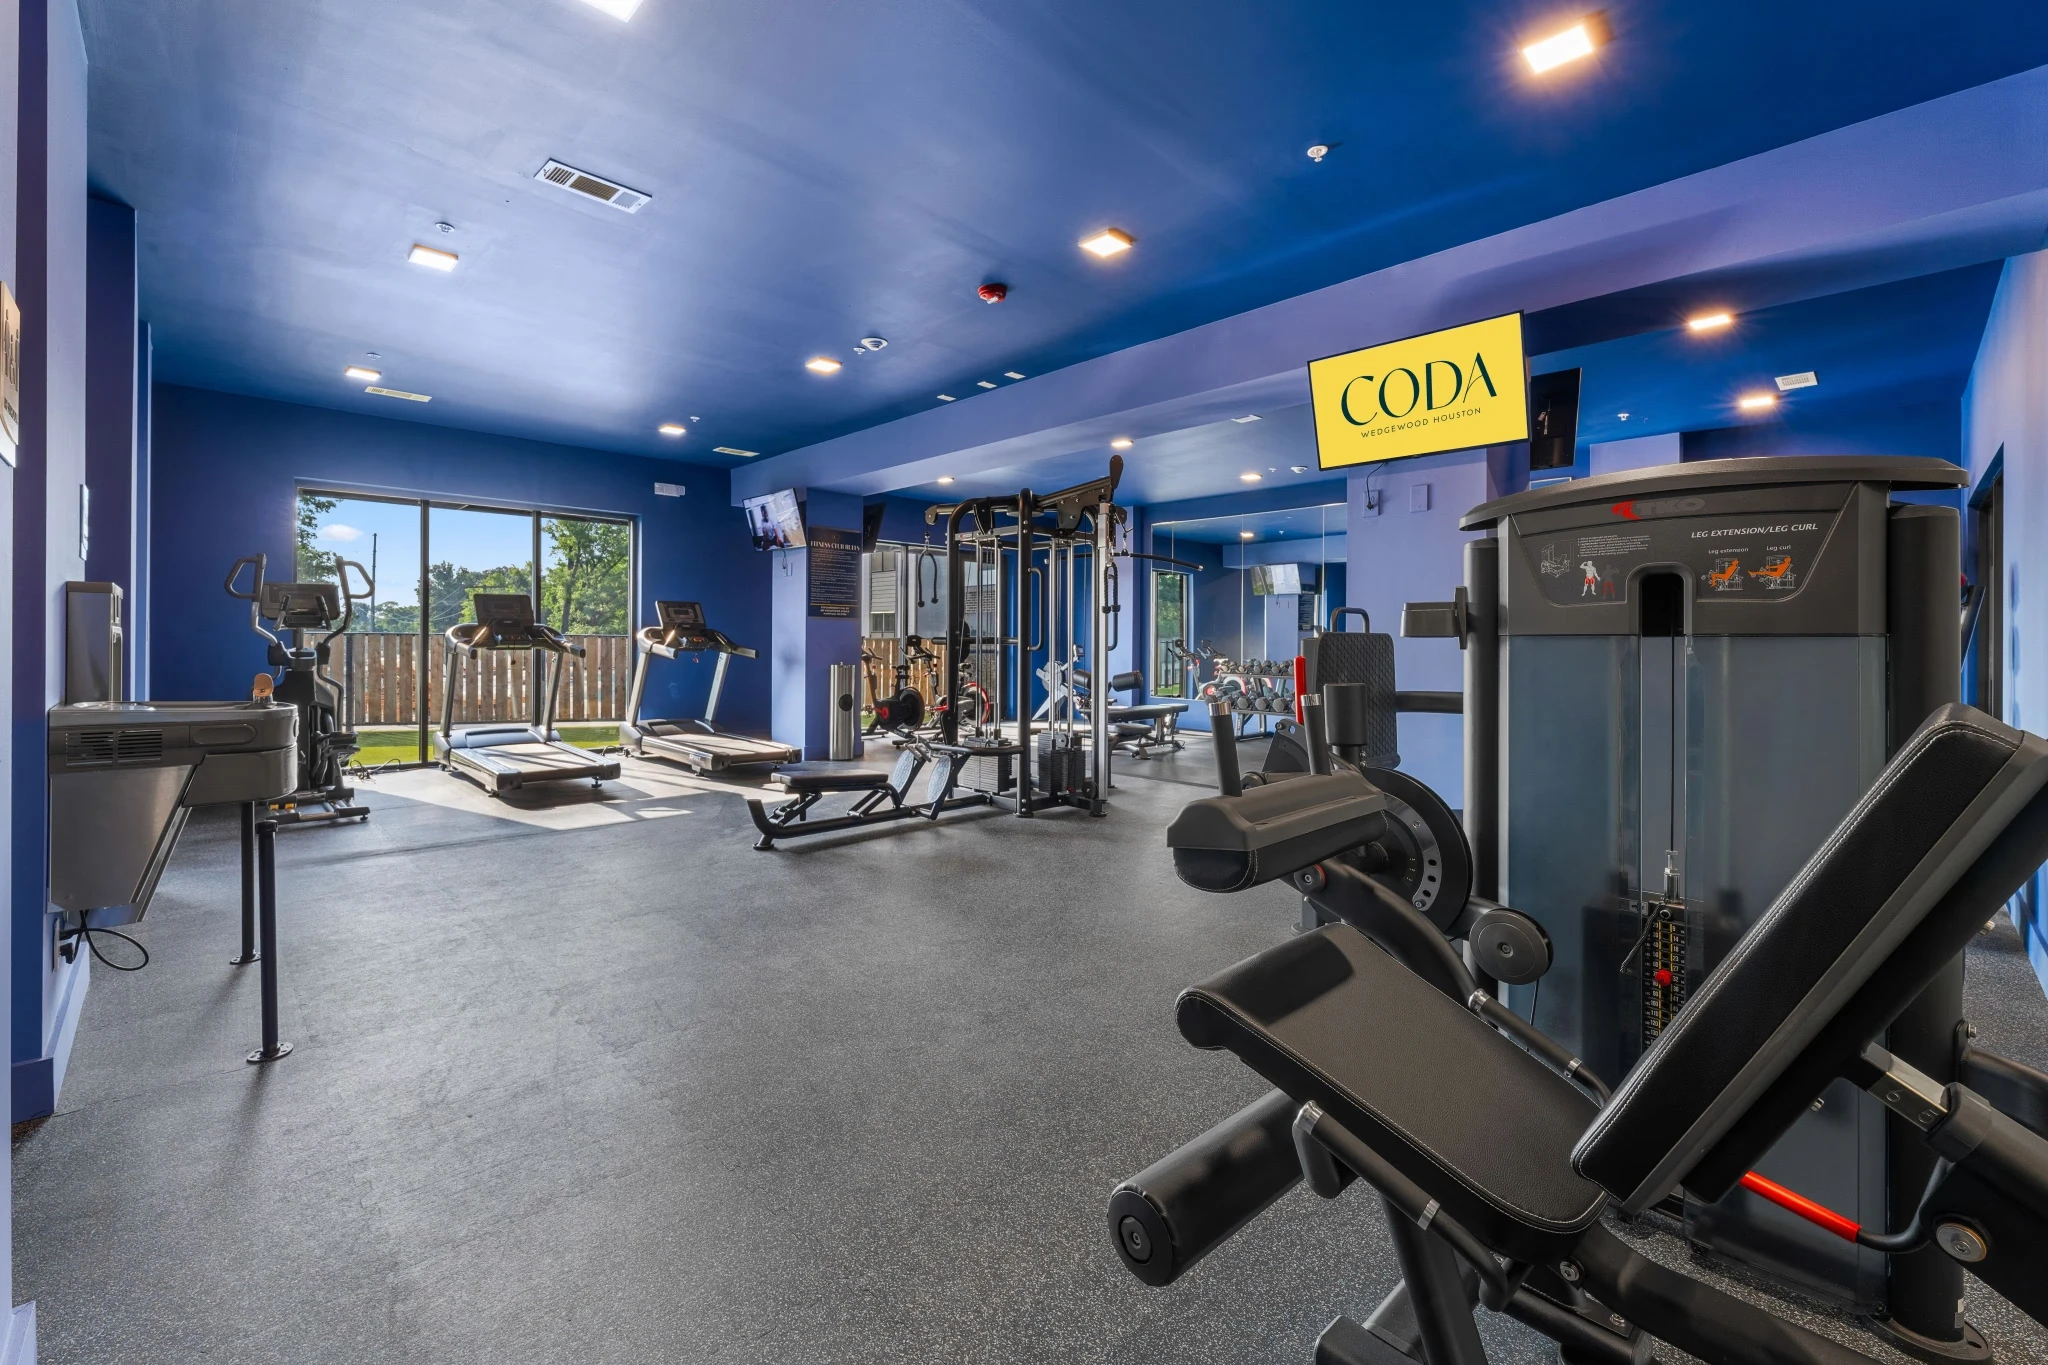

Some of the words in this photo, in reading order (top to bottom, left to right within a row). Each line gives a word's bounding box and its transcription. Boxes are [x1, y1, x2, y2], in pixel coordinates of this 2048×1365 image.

[1341, 352, 1497, 426] CODA
[1360, 417, 1429, 438] WEDGEWOOD
[1433, 407, 1481, 424] HOUSTON
[1691, 530, 1708, 538] LEG
[1710, 525, 1788, 537] EXTENSION/LEG
[1791, 523, 1818, 531] CURL
